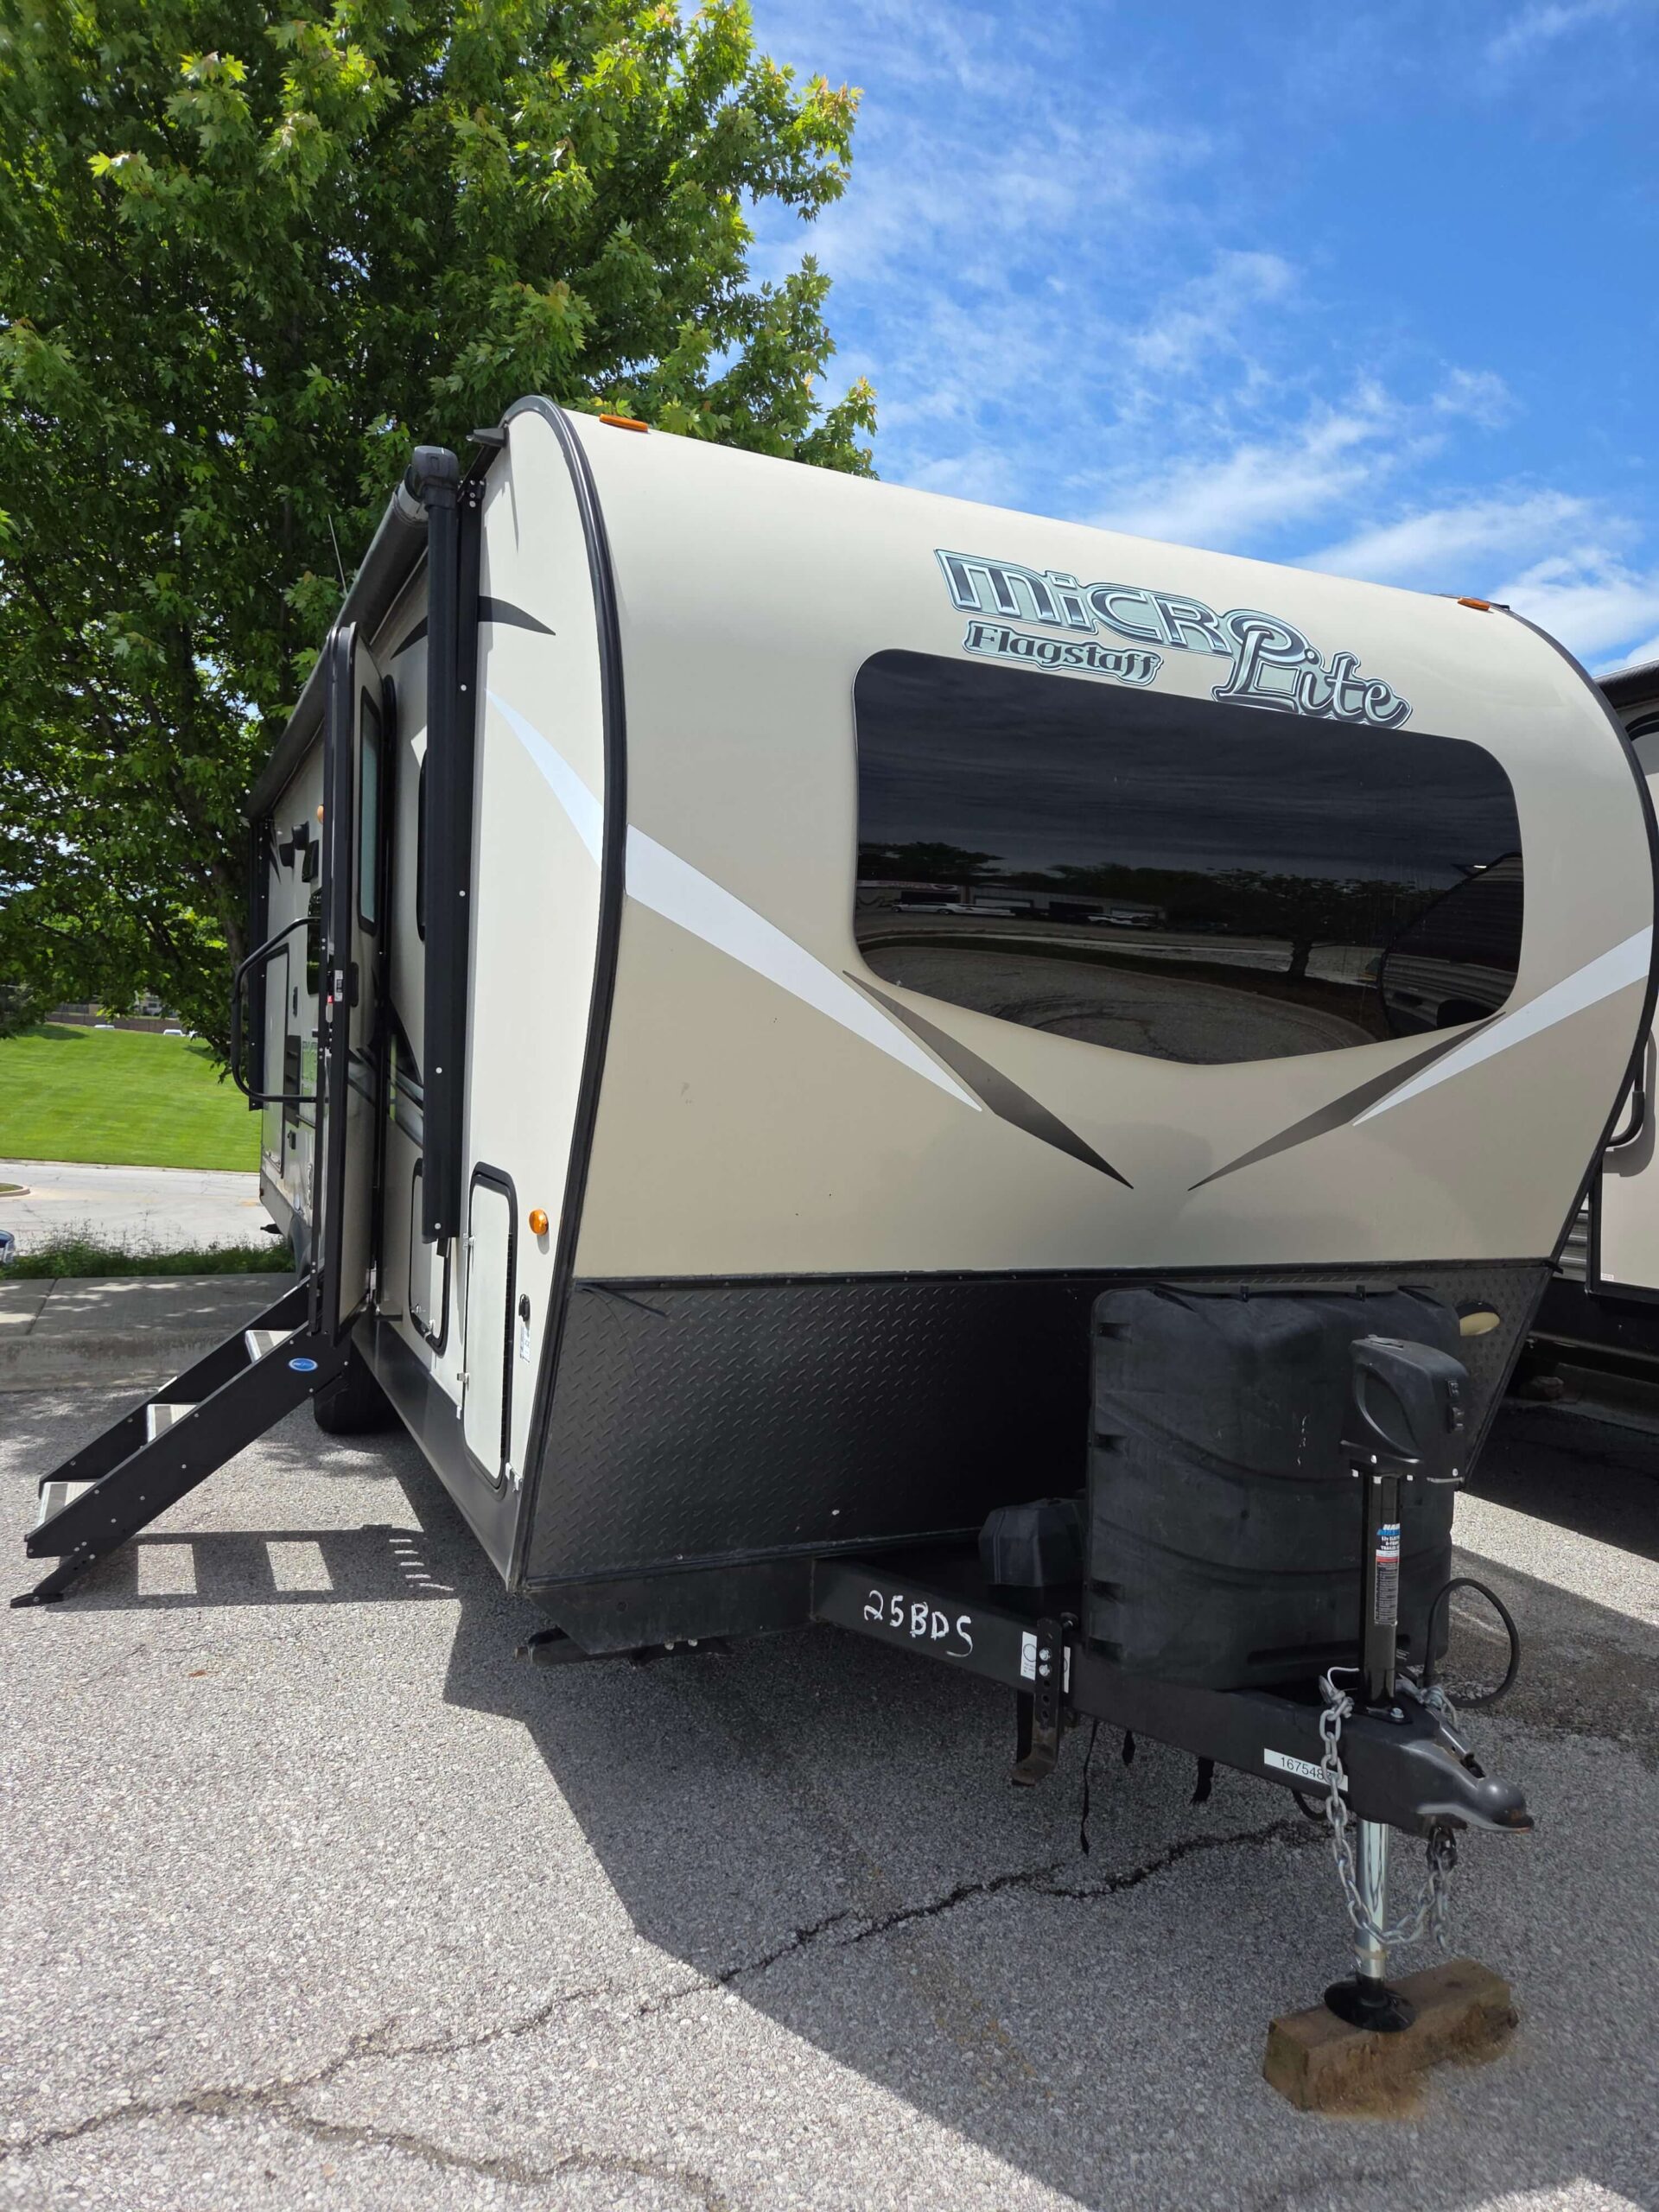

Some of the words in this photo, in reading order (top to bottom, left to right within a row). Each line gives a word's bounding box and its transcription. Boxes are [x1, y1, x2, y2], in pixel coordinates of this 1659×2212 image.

[969, 625, 1157, 680] Flagstaff
[1215, 625, 1411, 728] Lite
[863, 1589, 974, 1658] 25BDS
